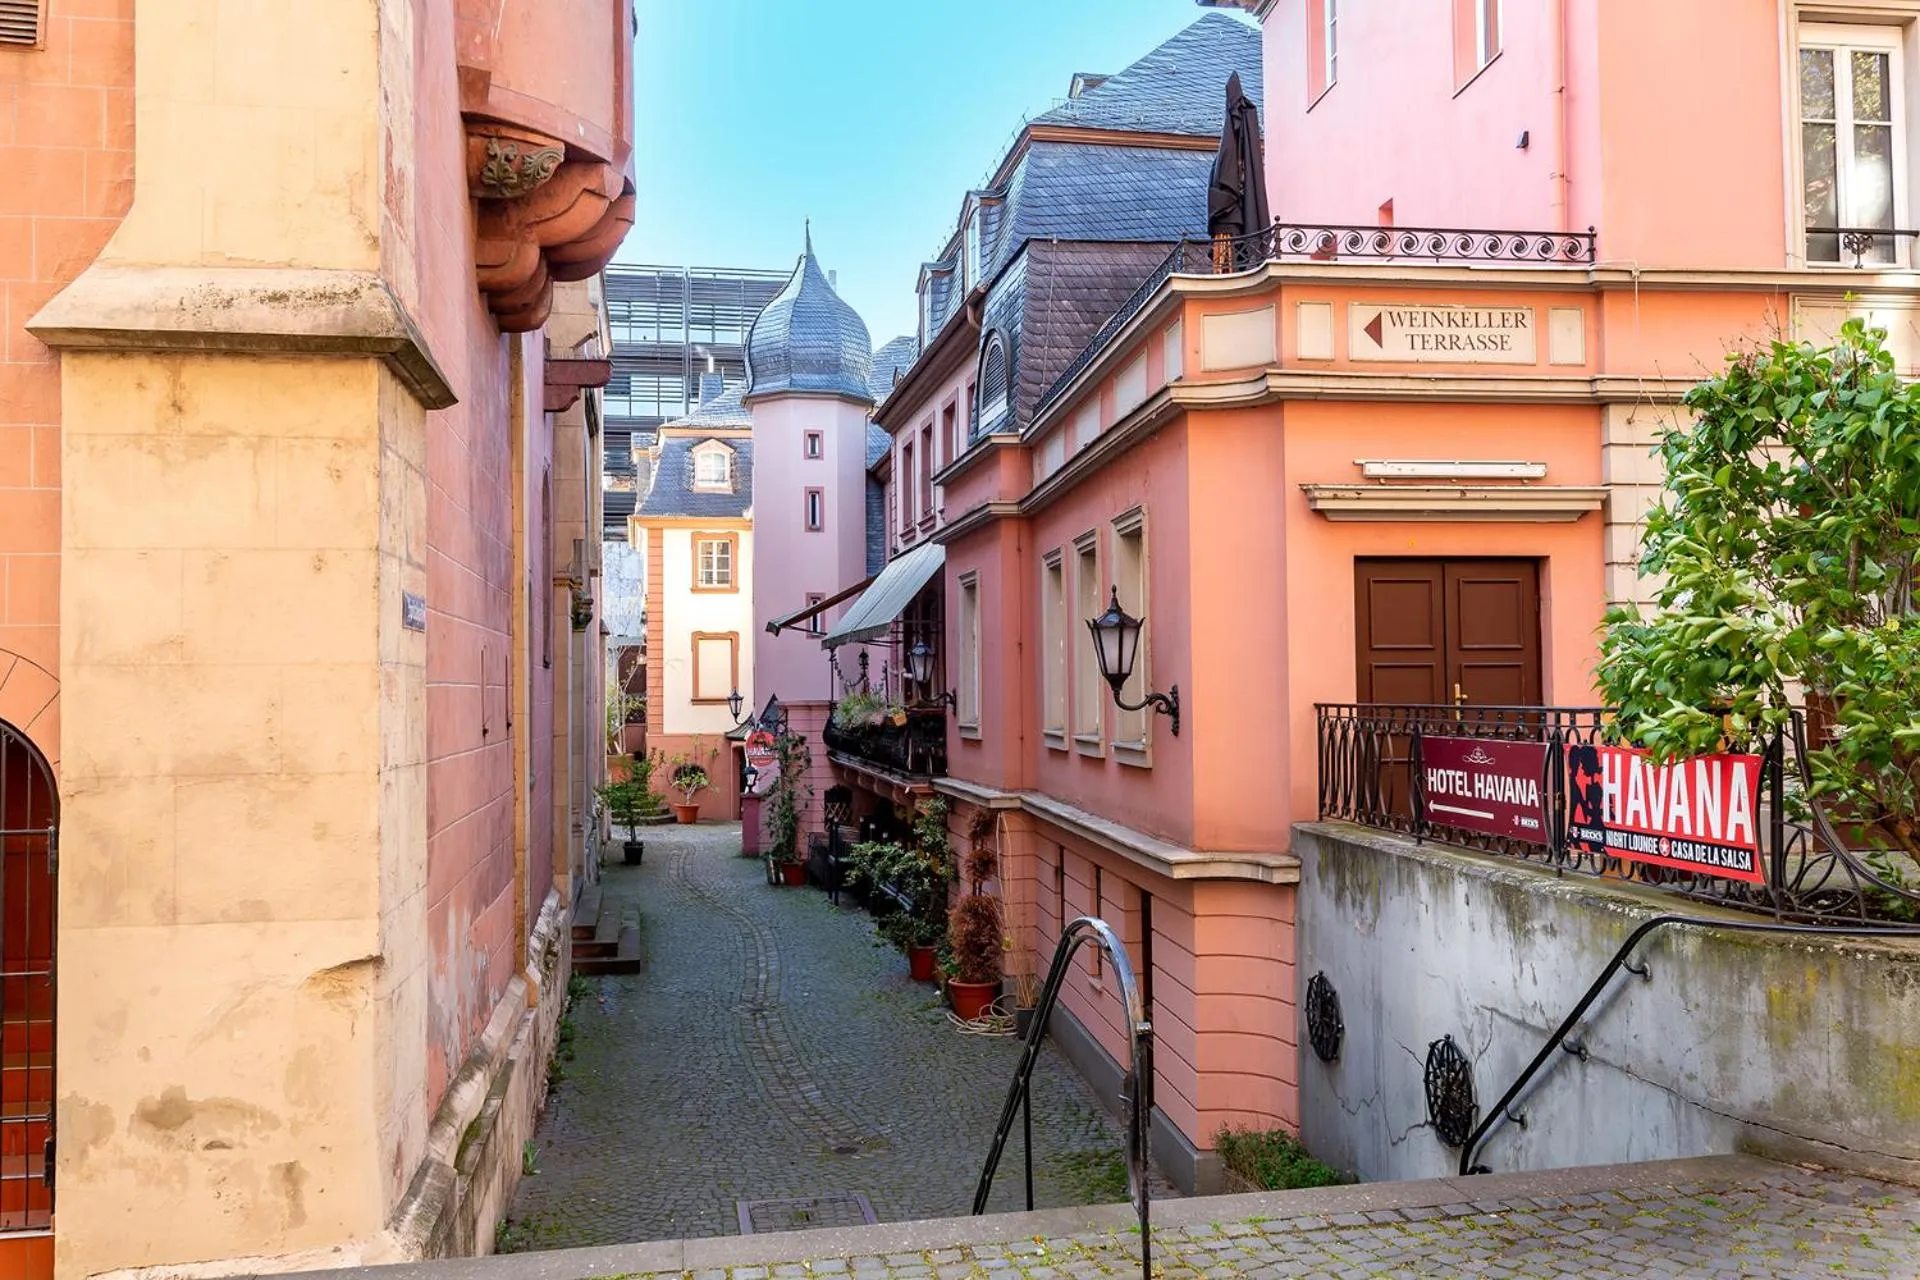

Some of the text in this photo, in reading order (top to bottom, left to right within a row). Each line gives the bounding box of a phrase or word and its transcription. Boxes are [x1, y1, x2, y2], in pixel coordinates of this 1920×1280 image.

[1387, 311, 1528, 329] WEINKELLER
[1405, 333, 1512, 351] TERRASSE
[1427, 767, 1540, 808] HOTEL HAVANA
[1602, 752, 1755, 845] HAVANA
[1605, 830, 1659, 855] NIGHT LOUNGE
[1671, 840, 1752, 871] CASA DE LA SALSA
